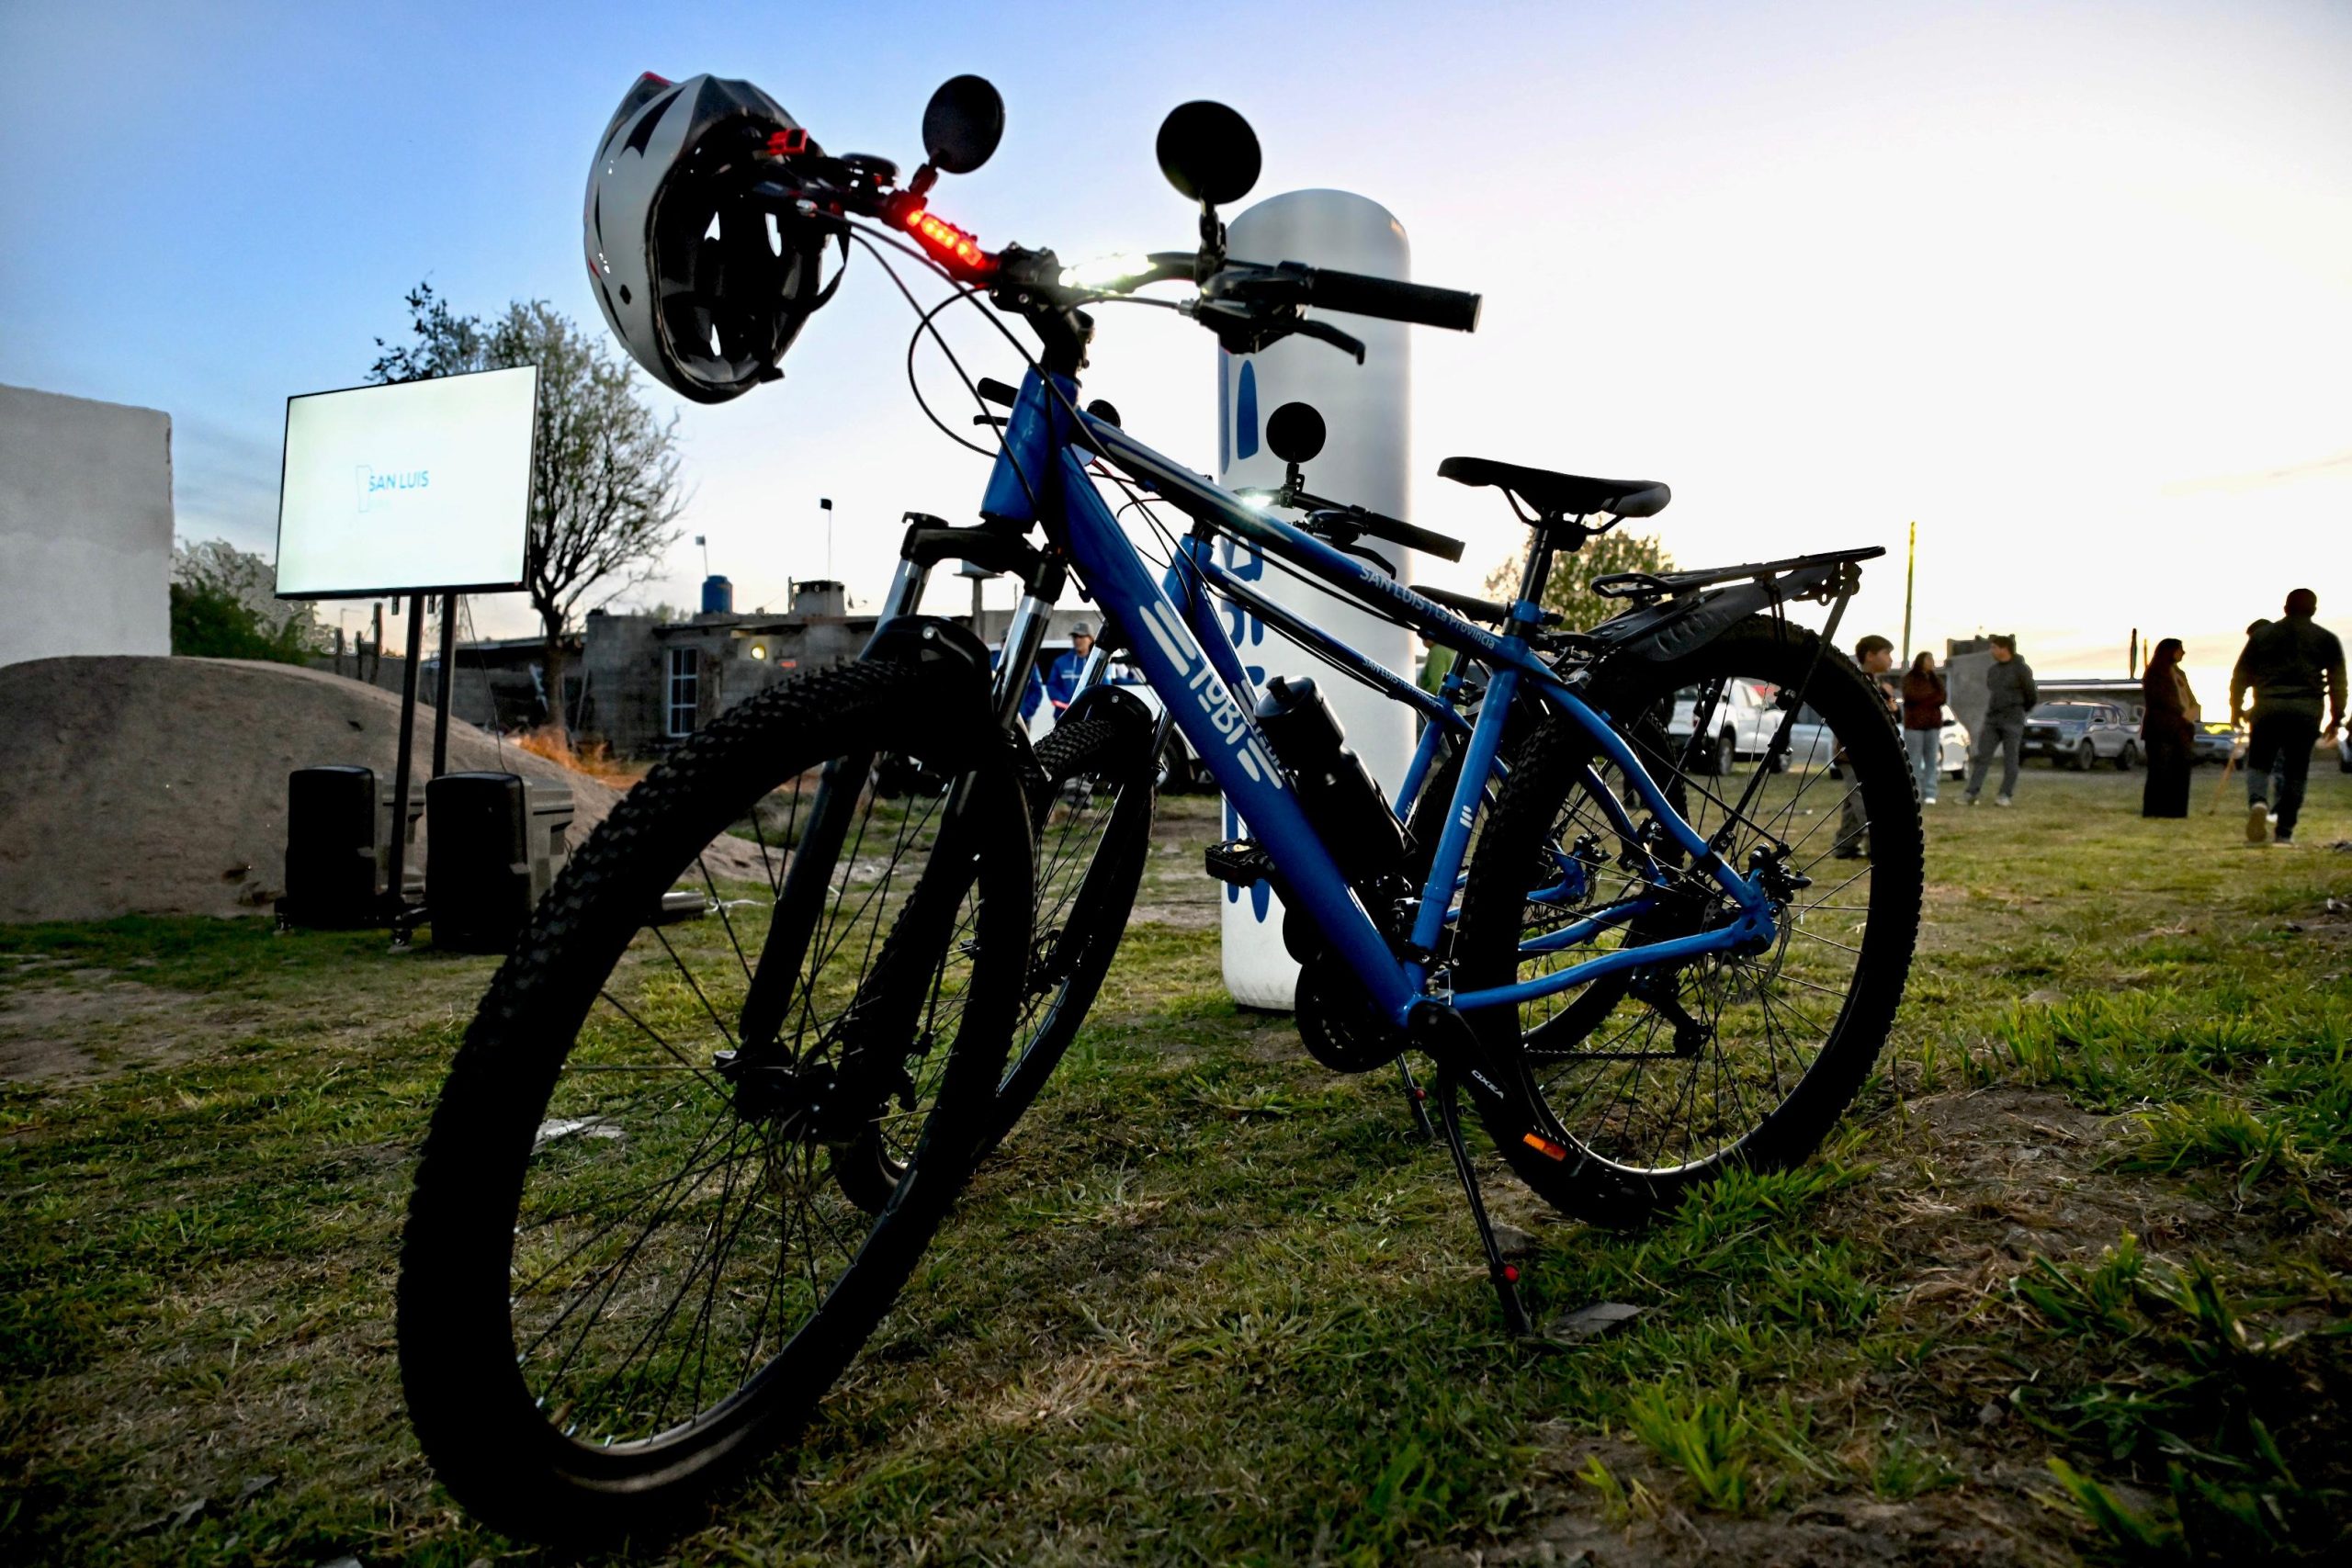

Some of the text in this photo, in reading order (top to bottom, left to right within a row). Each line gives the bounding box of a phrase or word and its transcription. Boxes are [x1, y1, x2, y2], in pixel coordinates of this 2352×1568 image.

[369, 470, 429, 491] SAN LUIS
[1360, 567, 1497, 650] SAN LUIS La Provincia
